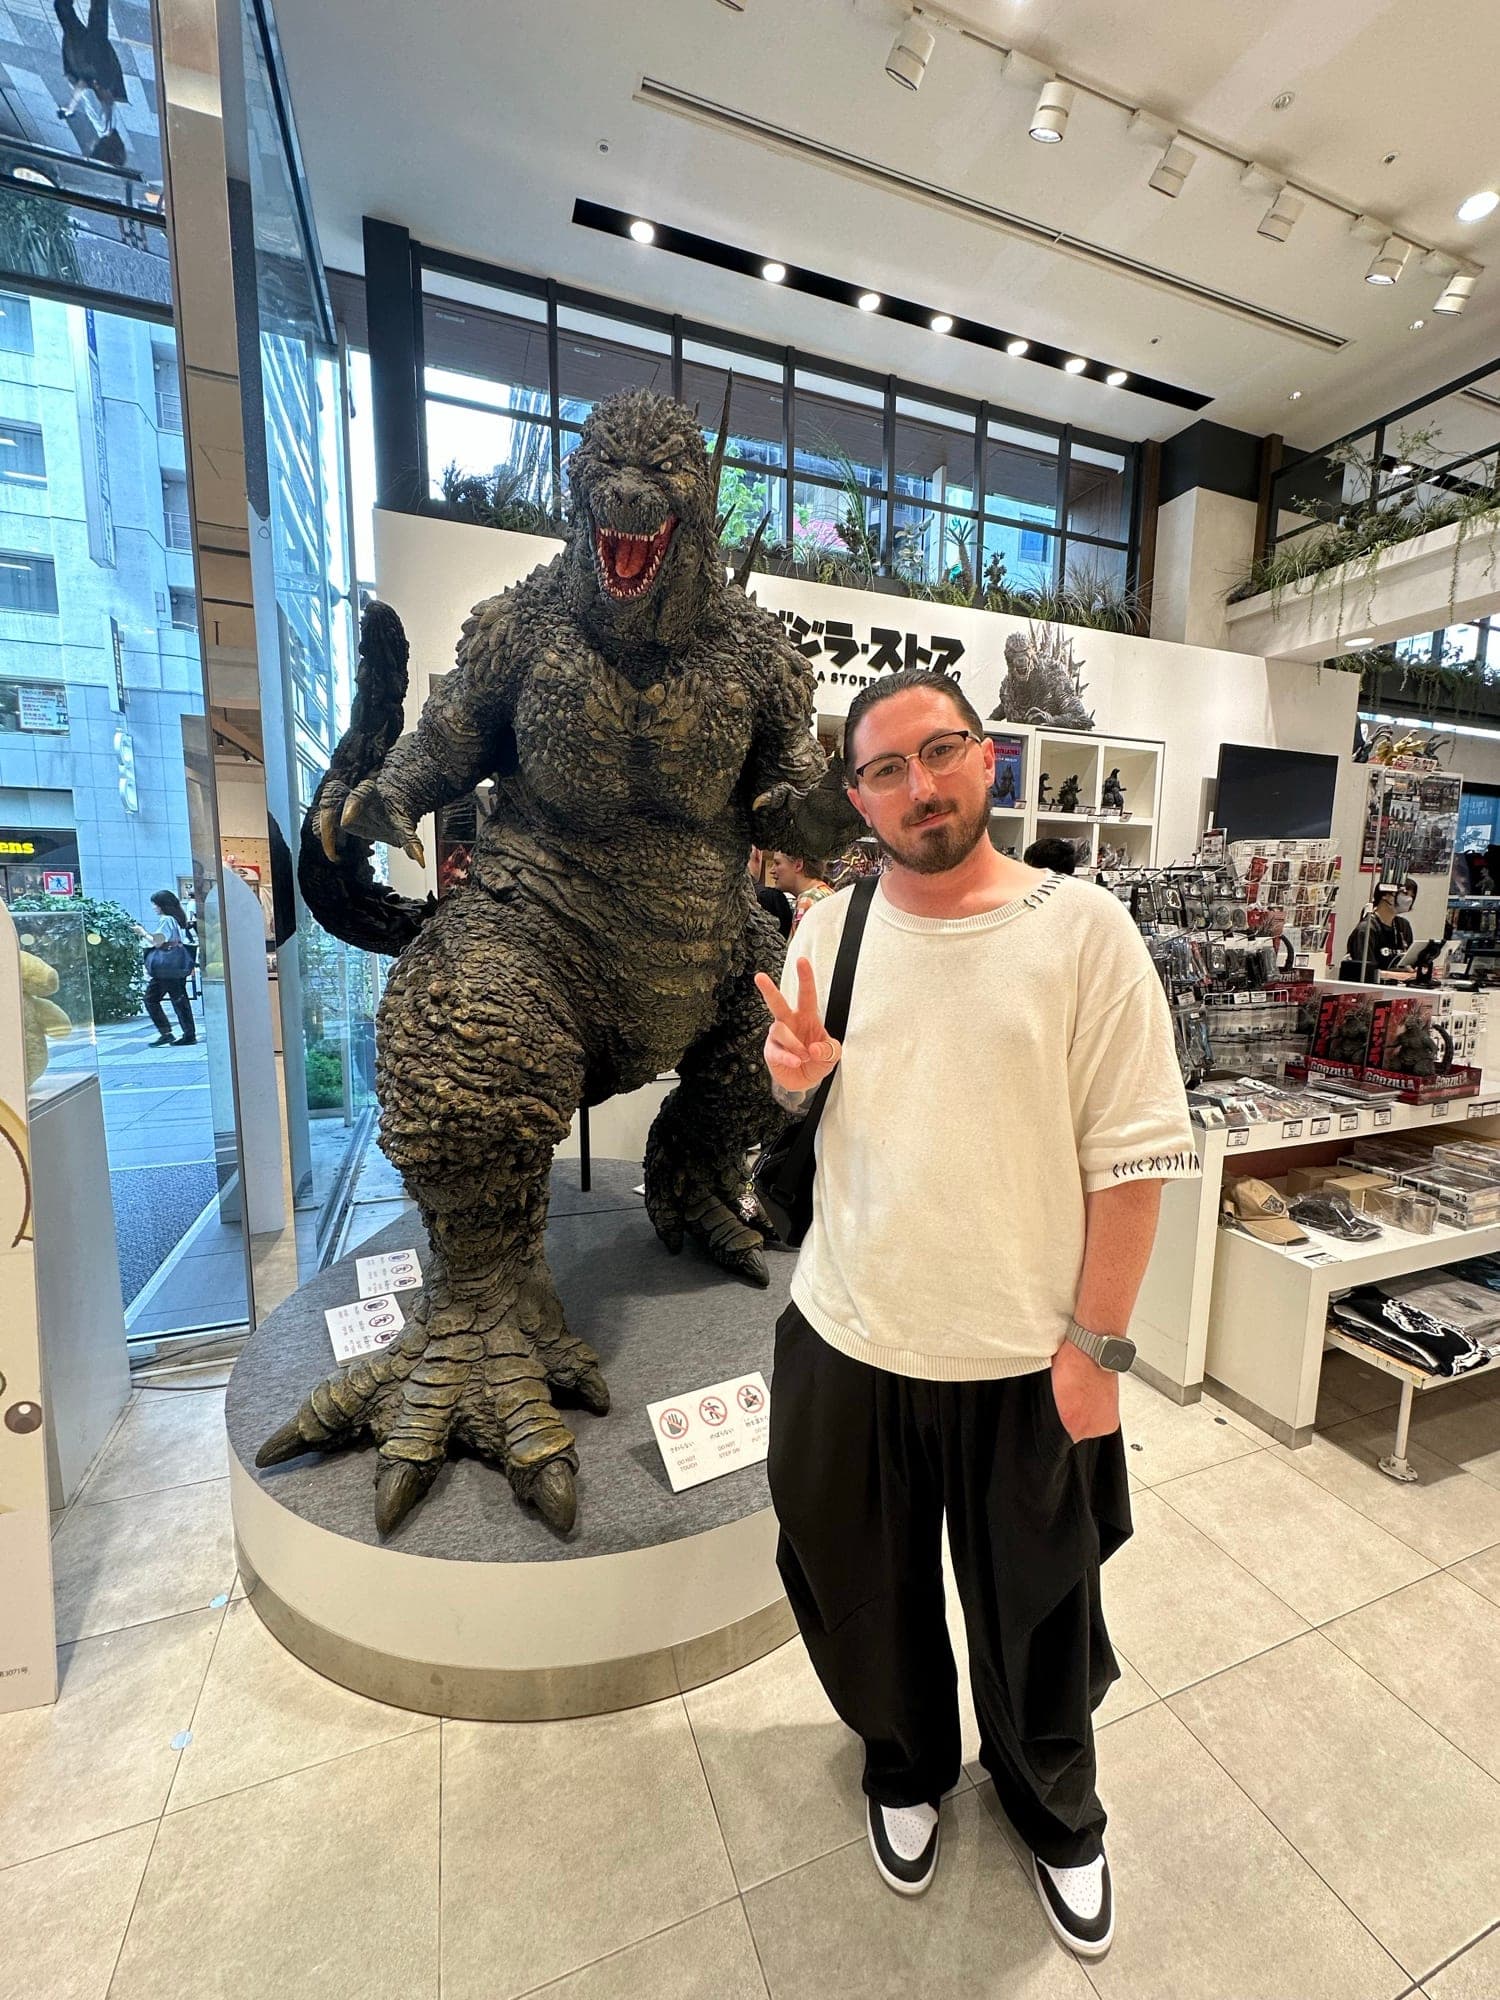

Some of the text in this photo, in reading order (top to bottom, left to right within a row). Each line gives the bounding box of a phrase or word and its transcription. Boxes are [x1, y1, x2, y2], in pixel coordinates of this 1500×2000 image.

[831, 672, 877, 688] STORE
[1309, 1060, 1355, 1079] GODZILLA
[1364, 1071, 1416, 1090] GODZILLA
[1435, 1071, 1468, 1089] GODZILLA
